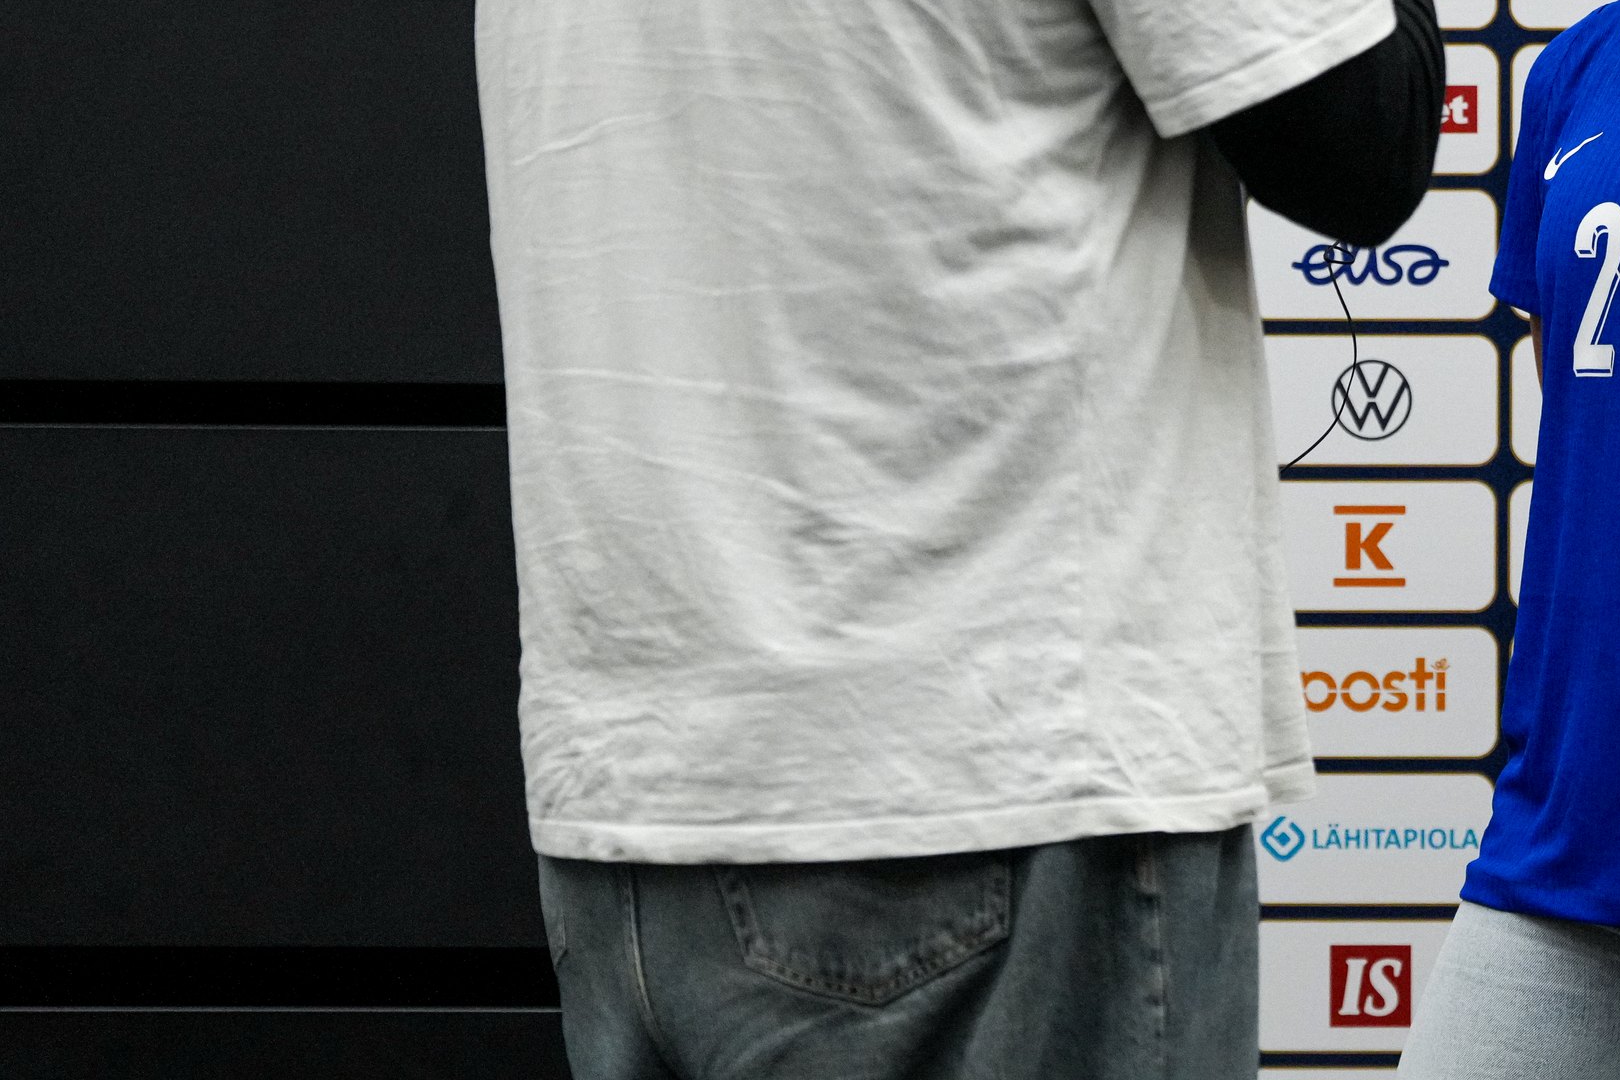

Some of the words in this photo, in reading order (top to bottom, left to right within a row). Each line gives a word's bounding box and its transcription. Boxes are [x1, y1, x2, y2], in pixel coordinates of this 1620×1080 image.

[1345, 522, 1394, 570] K
[1312, 823, 1479, 850] LÄHITAPIOLA
[1338, 958, 1402, 1017] IS
